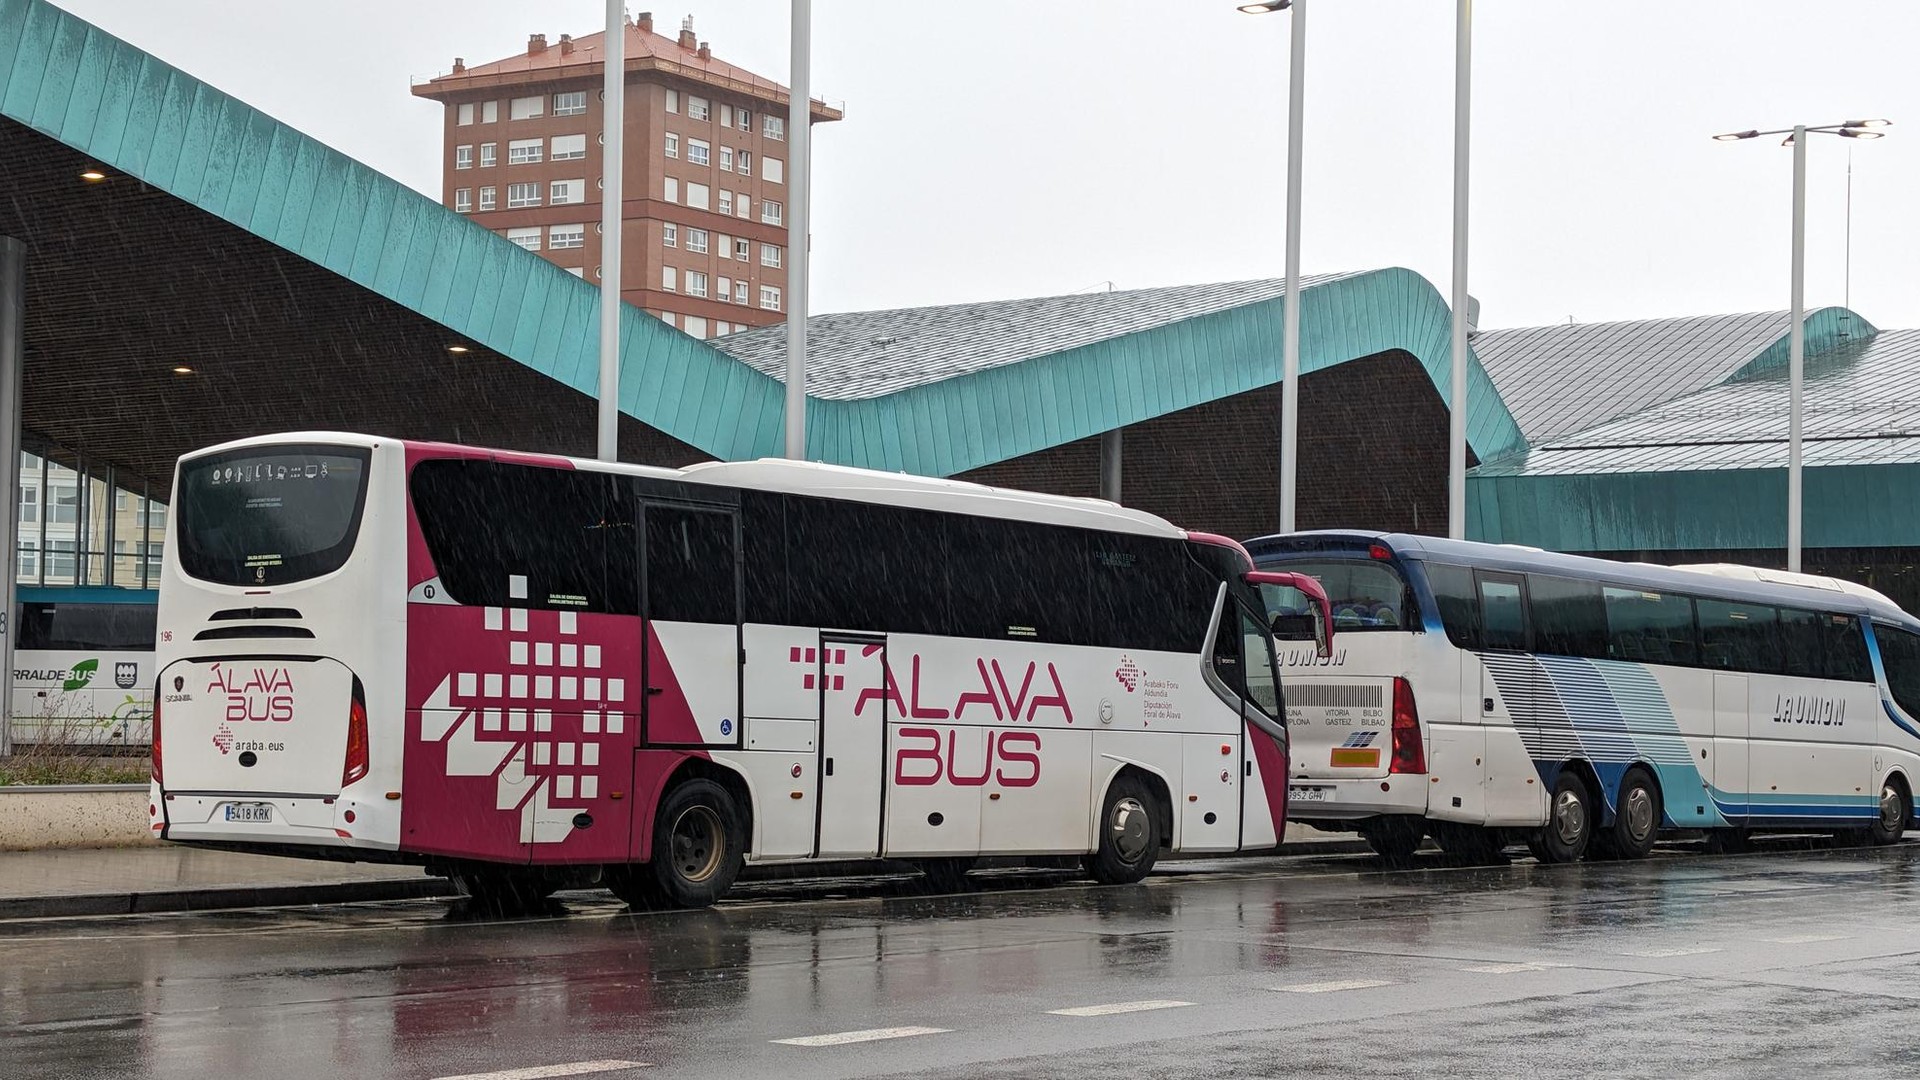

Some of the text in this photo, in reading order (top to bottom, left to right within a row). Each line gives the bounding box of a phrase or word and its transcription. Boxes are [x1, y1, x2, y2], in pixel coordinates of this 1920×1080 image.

[160, 631, 173, 642] 196
[207, 663, 293, 693] ÁLAVA
[854, 644, 1073, 724] ÁLAVA
[226, 696, 293, 721] BUS
[1362, 709, 1383, 717] BILBO
[895, 728, 1042, 787] BUS
[231, 807, 270, 820] 5418 KRK
